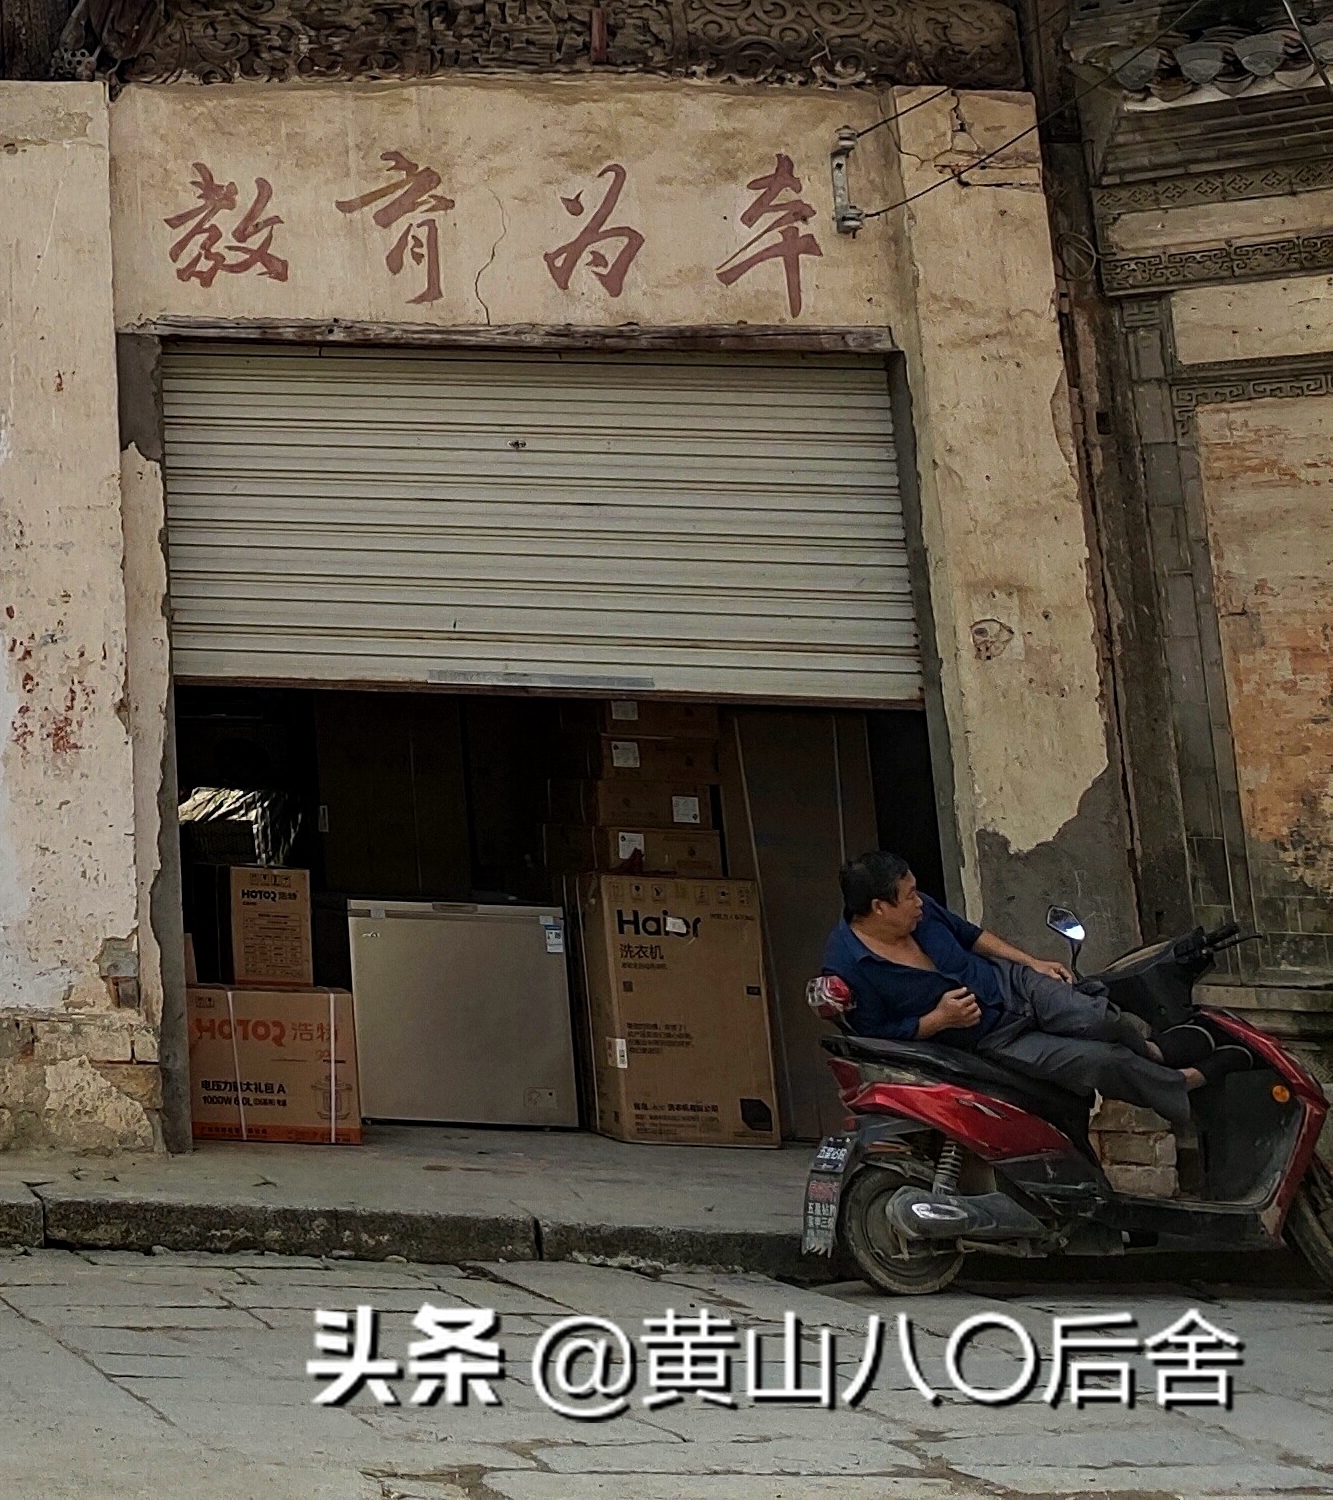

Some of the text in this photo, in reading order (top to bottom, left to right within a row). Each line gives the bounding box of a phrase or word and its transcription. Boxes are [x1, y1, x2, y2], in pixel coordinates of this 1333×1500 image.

[163, 151, 824, 318] 教育为本
[619, 943, 665, 960] 洗衣机
